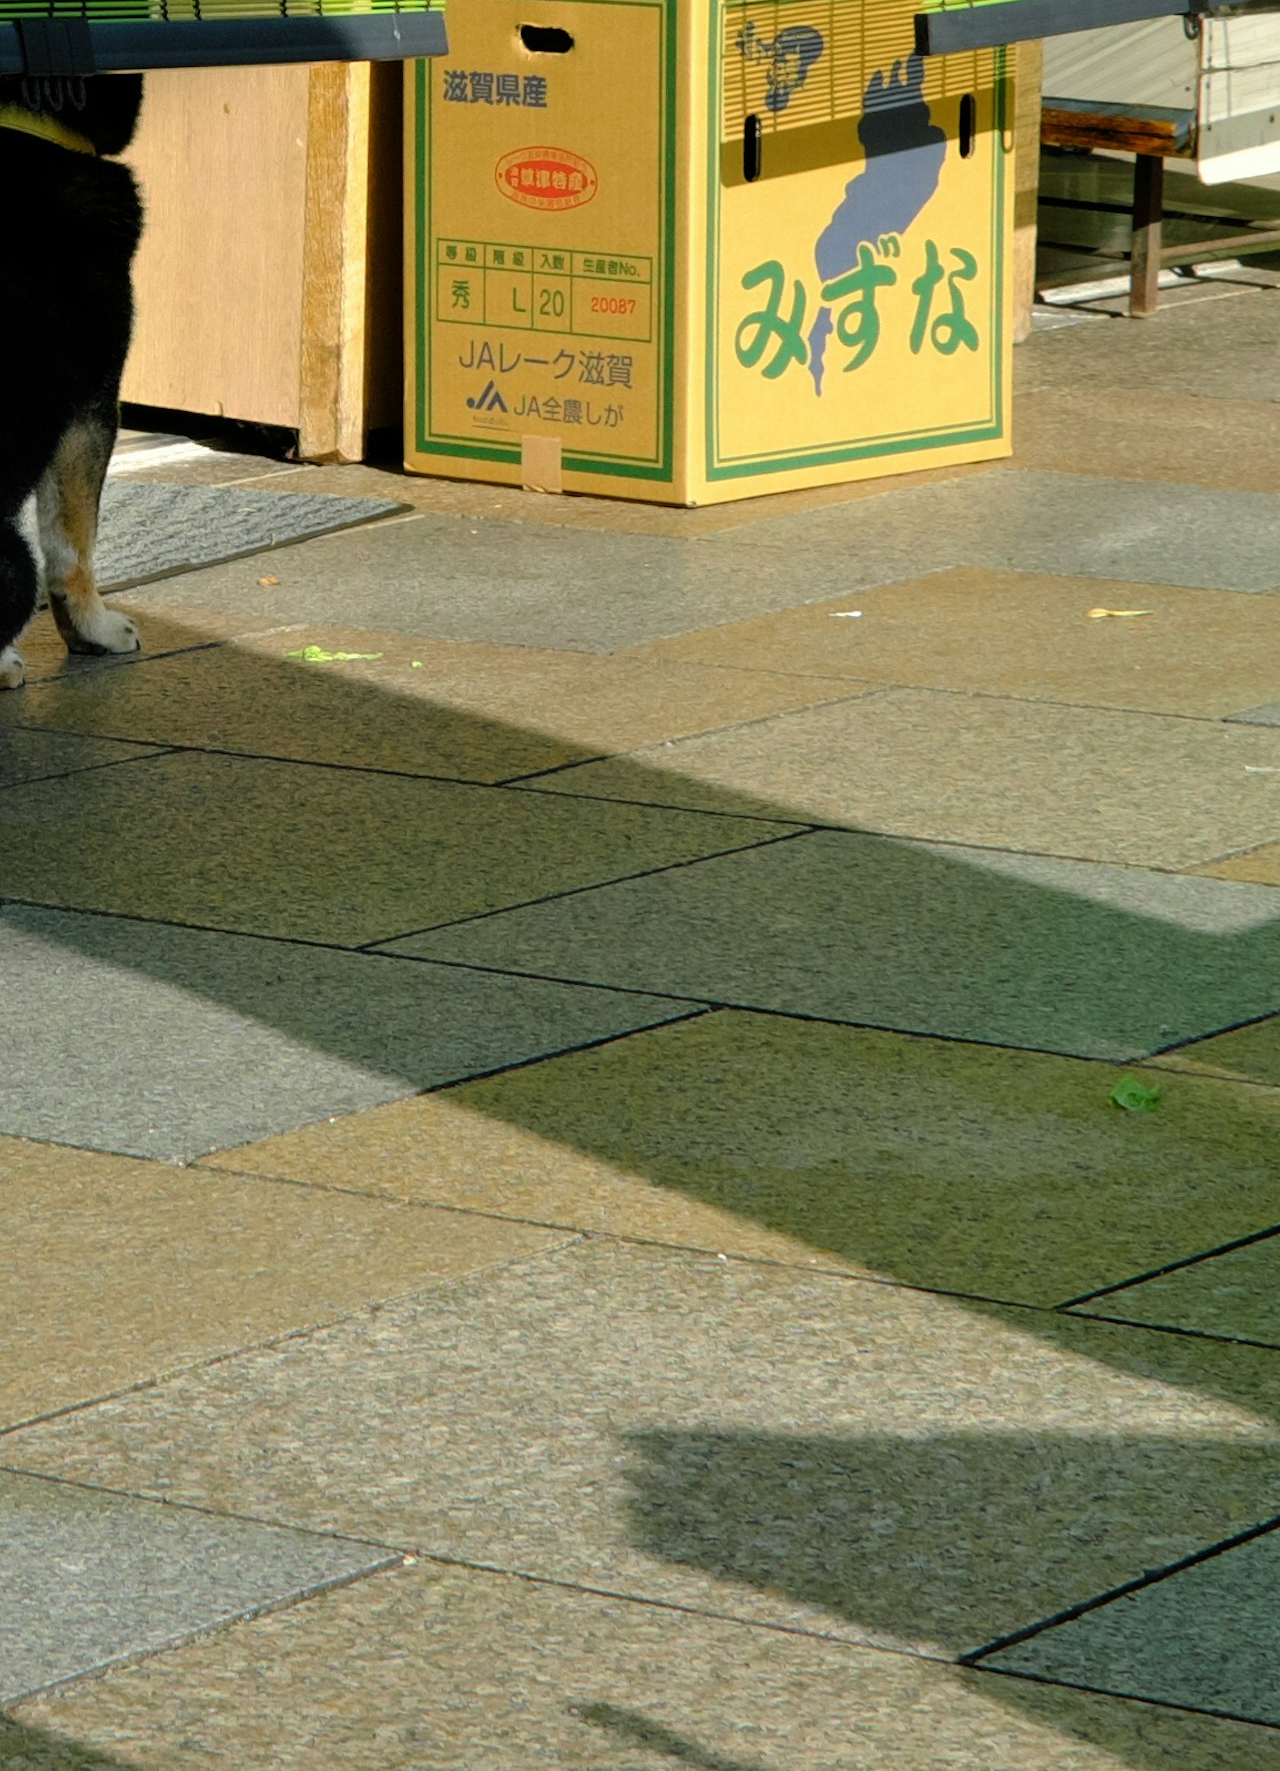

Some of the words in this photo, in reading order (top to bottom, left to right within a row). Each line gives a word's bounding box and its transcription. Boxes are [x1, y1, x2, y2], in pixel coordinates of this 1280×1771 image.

[443, 69, 548, 108] 滋賀県産
[445, 244, 477, 263] 等級
[492, 249, 525, 267] 階級
[539, 253, 565, 270] 入数
[582, 258, 641, 277] 生産者No.
[451, 279, 470, 309] 秀
[512, 286, 526, 313] L
[539, 288, 565, 317] 20
[734, 234, 980, 380] みずな
[458, 339, 633, 390] JAレーク滋賀
[513, 394, 625, 428] JA全農しが
